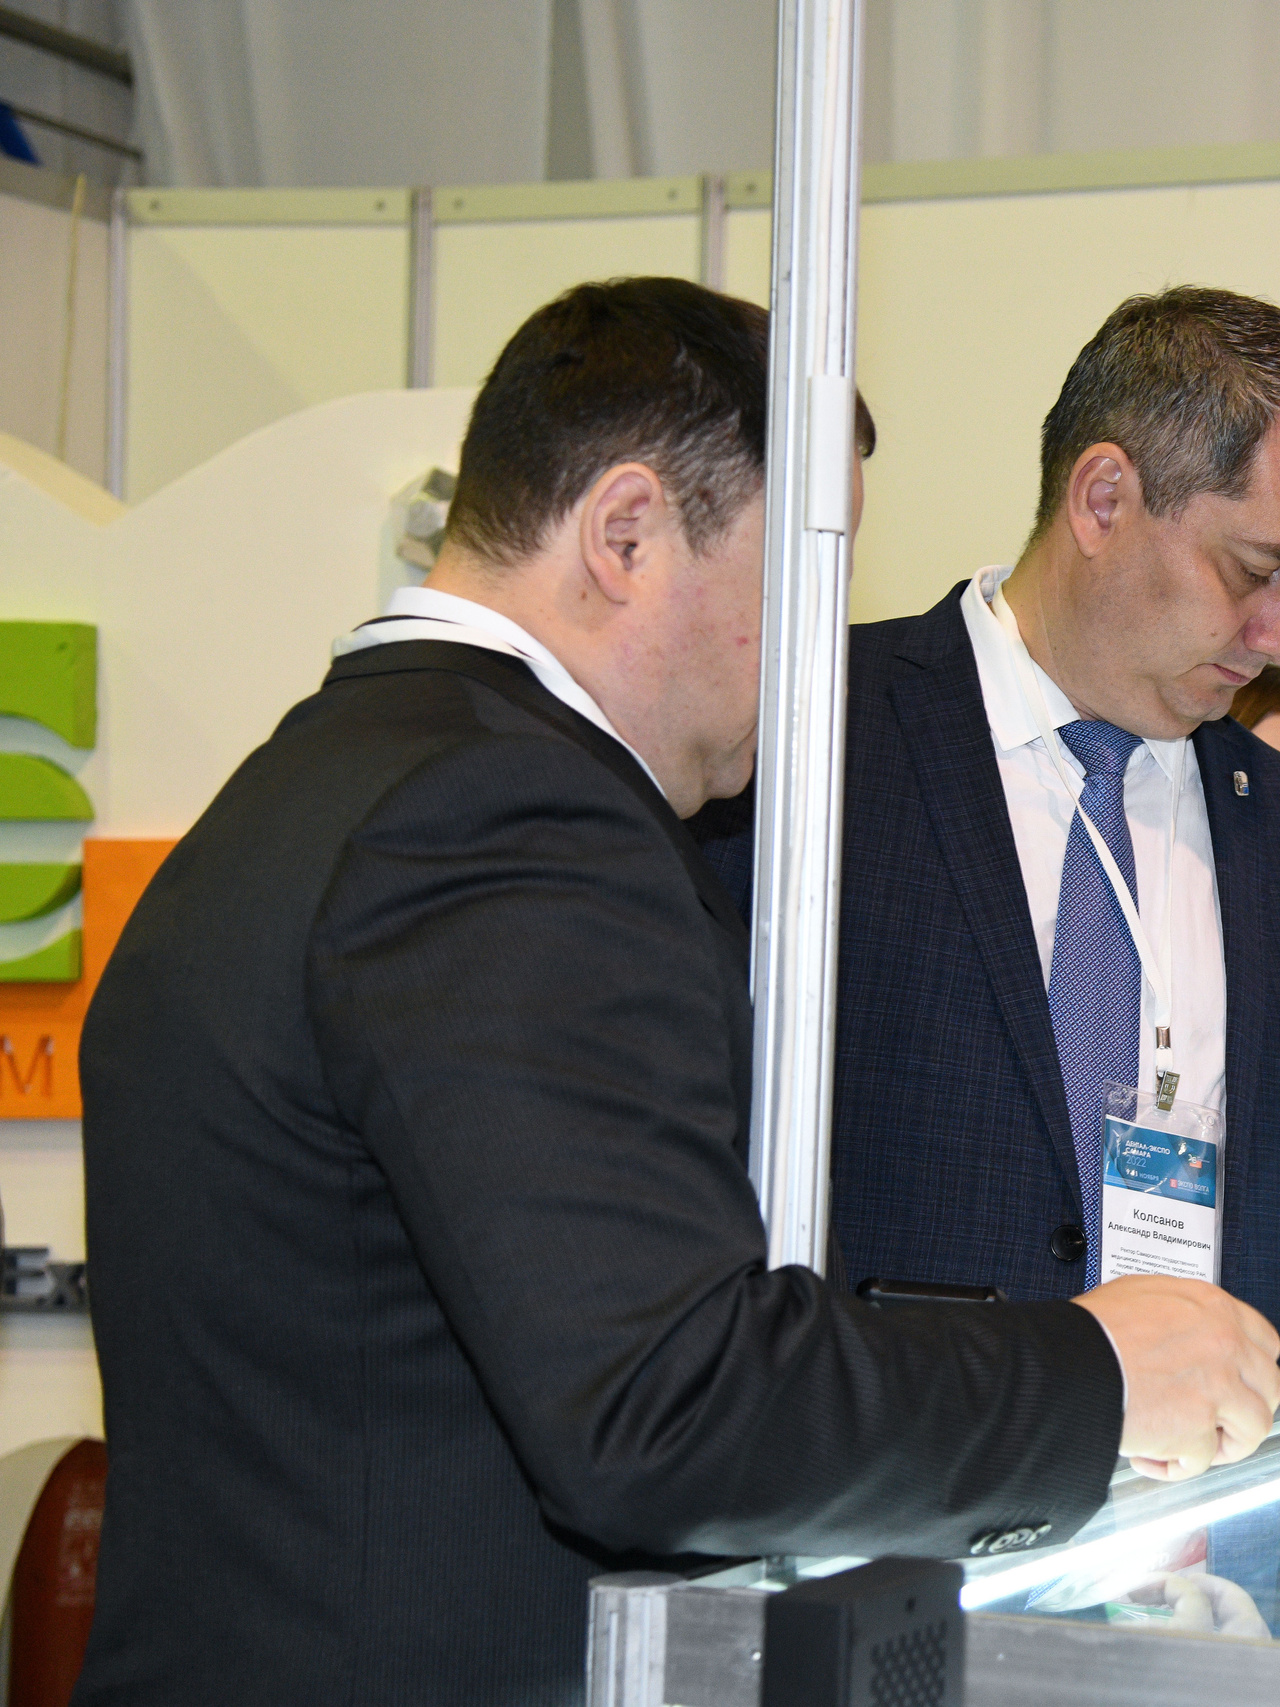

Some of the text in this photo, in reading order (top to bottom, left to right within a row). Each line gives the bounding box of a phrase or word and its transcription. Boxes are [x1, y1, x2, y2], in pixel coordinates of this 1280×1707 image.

[1126, 1154, 1147, 1168] 2022
[1133, 1208, 1184, 1230] Колсанов
[1107, 1221, 1211, 1251] Александр Владимирович
